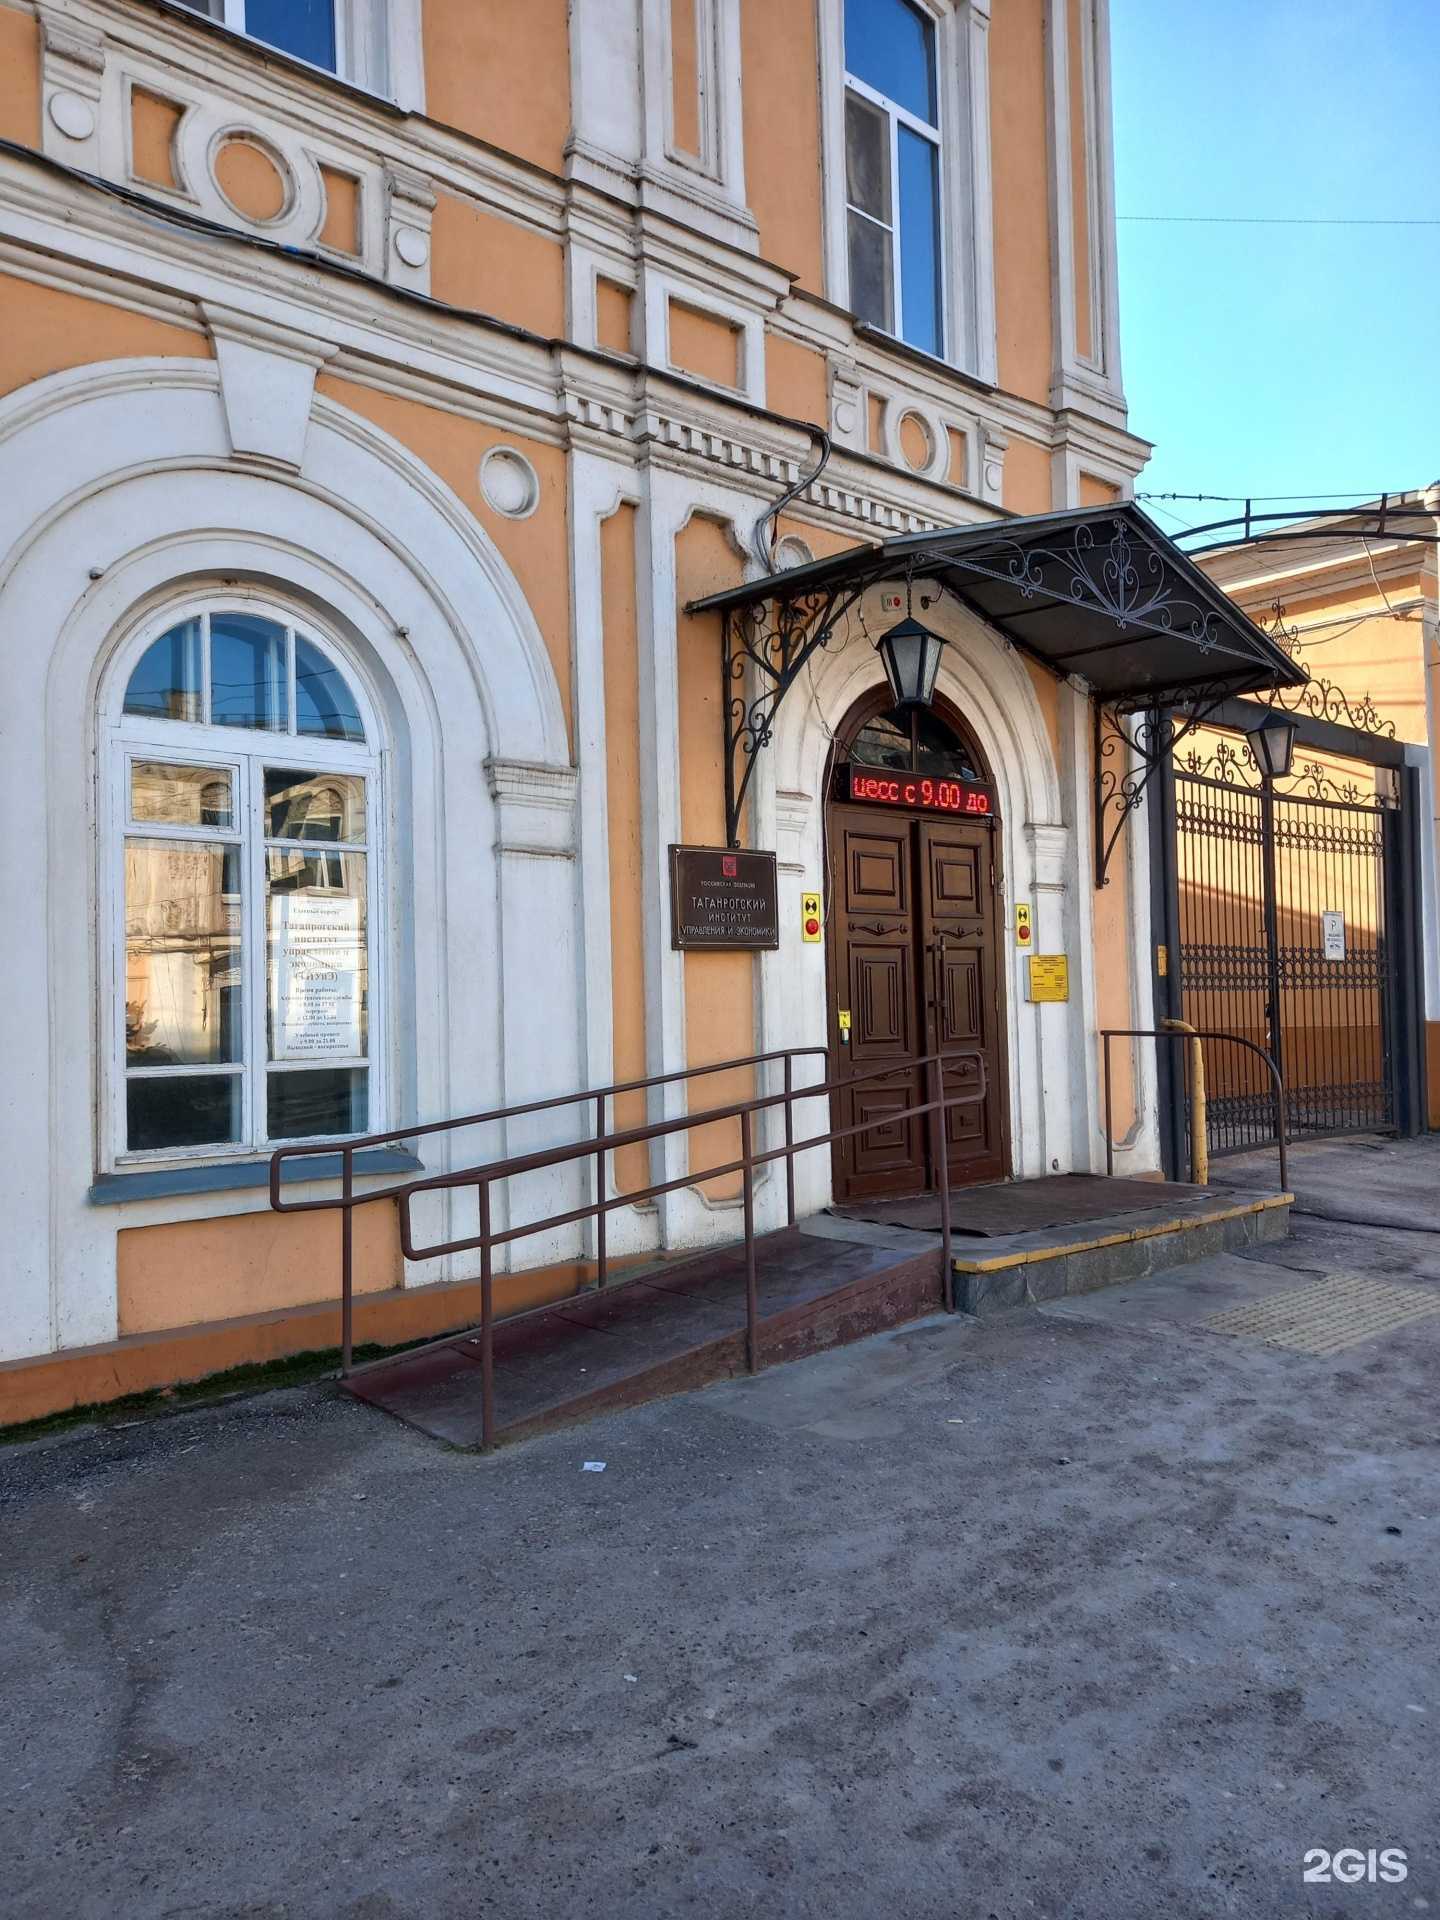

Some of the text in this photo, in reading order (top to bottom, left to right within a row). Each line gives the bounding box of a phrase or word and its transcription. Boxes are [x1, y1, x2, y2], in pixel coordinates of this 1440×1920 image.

[854, 777, 988, 812] цесс с 9.00 до
[692, 897, 766, 911] ТАГАНРОГСКИЙ
[708, 913, 751, 922] ИНСТИТУТ
[681, 925, 775, 937] УПРАВЛЕНИЯ И ЭКОНОМИКИ
